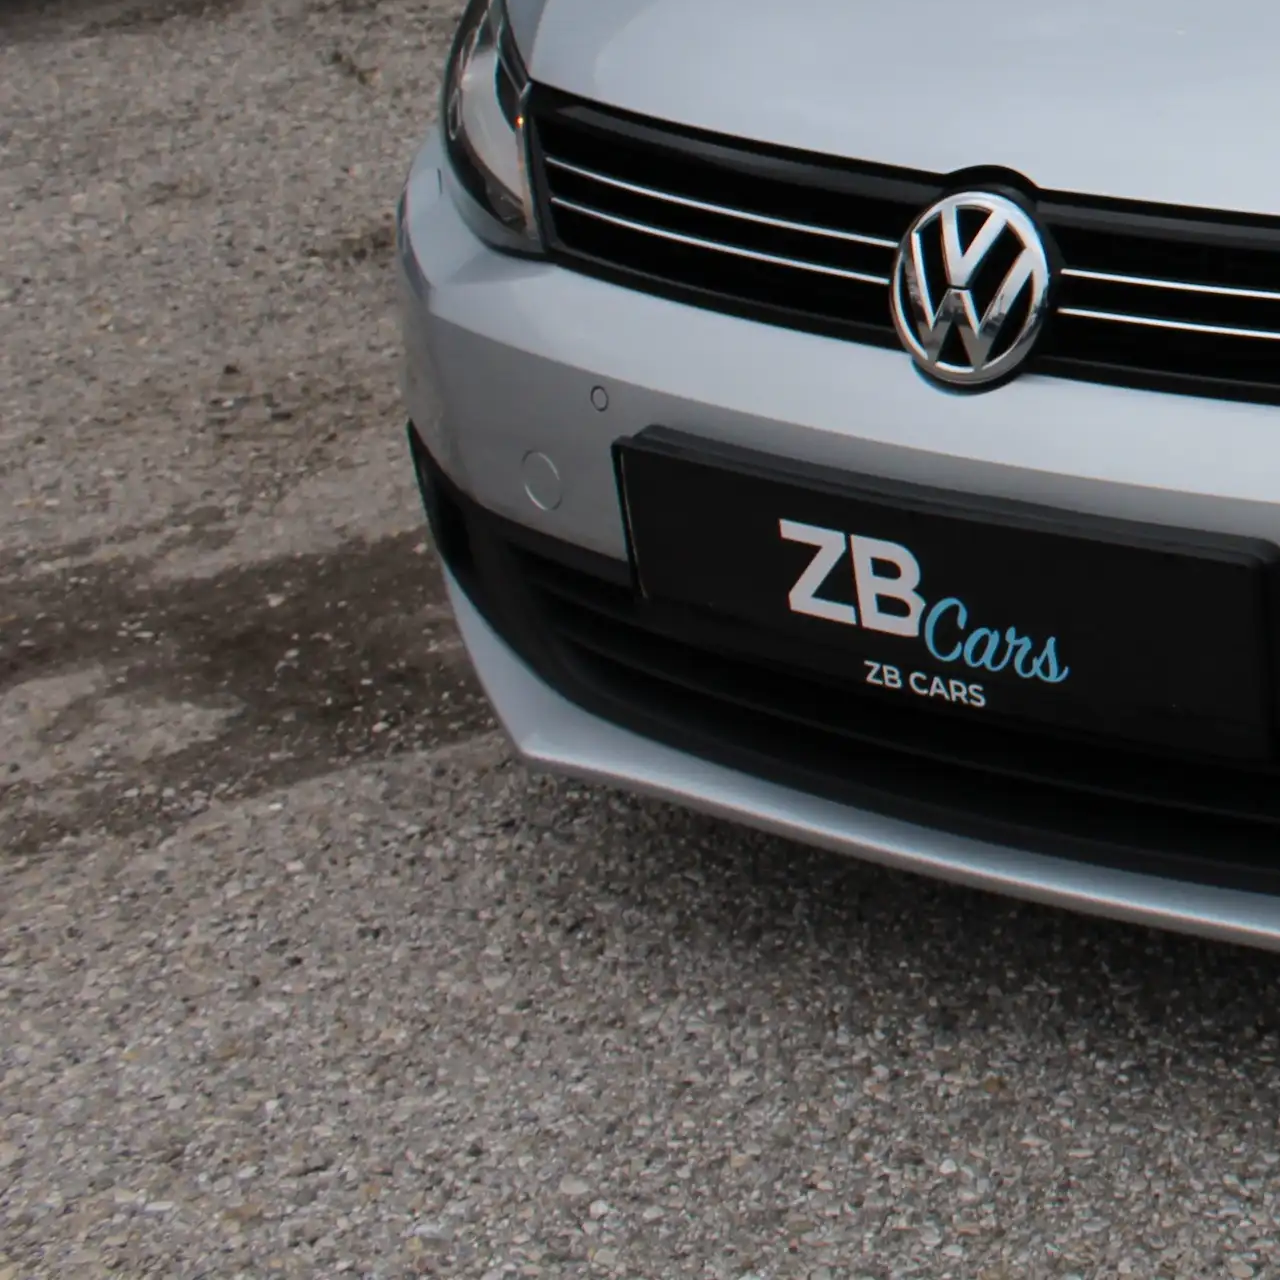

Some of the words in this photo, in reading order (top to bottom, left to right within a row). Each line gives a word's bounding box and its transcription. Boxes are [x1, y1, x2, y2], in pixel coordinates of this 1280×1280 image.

[779, 518, 926, 638] ZB
[924, 597, 1070, 683] Cars
[864, 660, 902, 689] ZB
[908, 671, 987, 708] CARS
